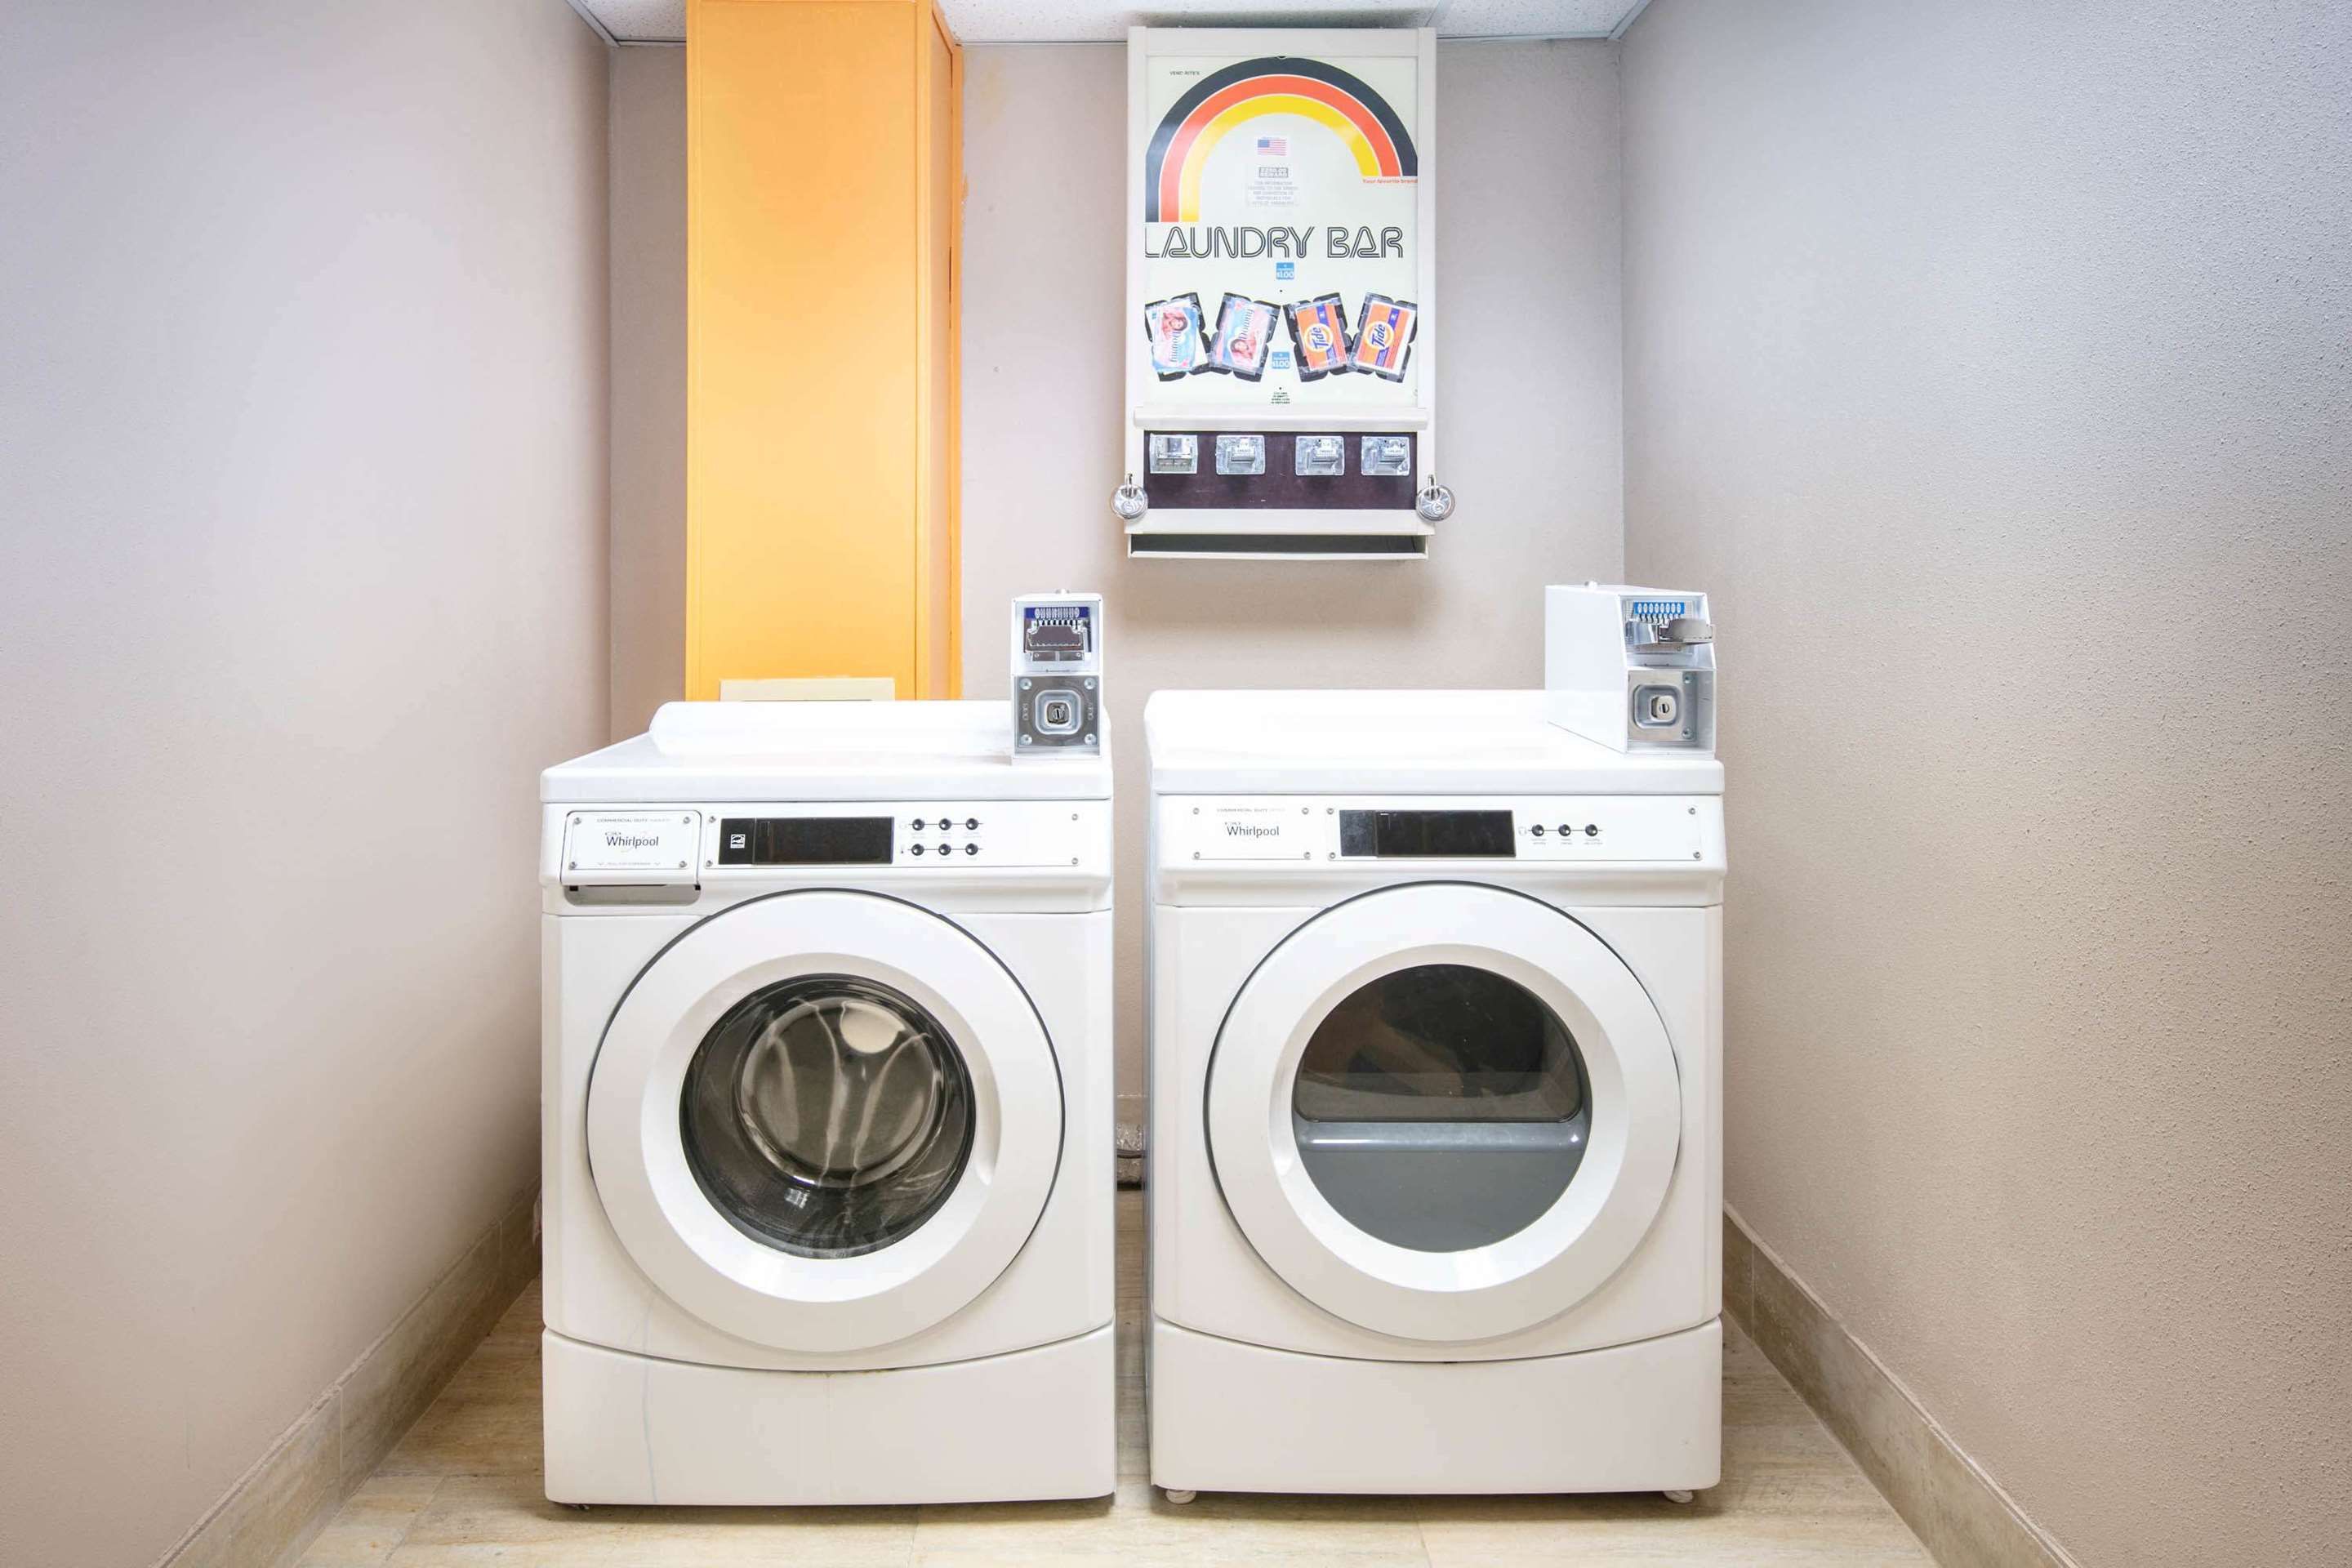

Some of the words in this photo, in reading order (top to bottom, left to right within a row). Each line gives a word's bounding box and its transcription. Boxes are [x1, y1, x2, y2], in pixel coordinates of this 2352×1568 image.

[1145, 226, 1315, 259] LAUNDRY
[1327, 226, 1404, 259] BAR
[1312, 327, 1330, 350] Tide
[1371, 323, 1386, 348] Tide
[606, 835, 659, 849] Whirlpool
[1227, 826, 1280, 839] Whirlpool
